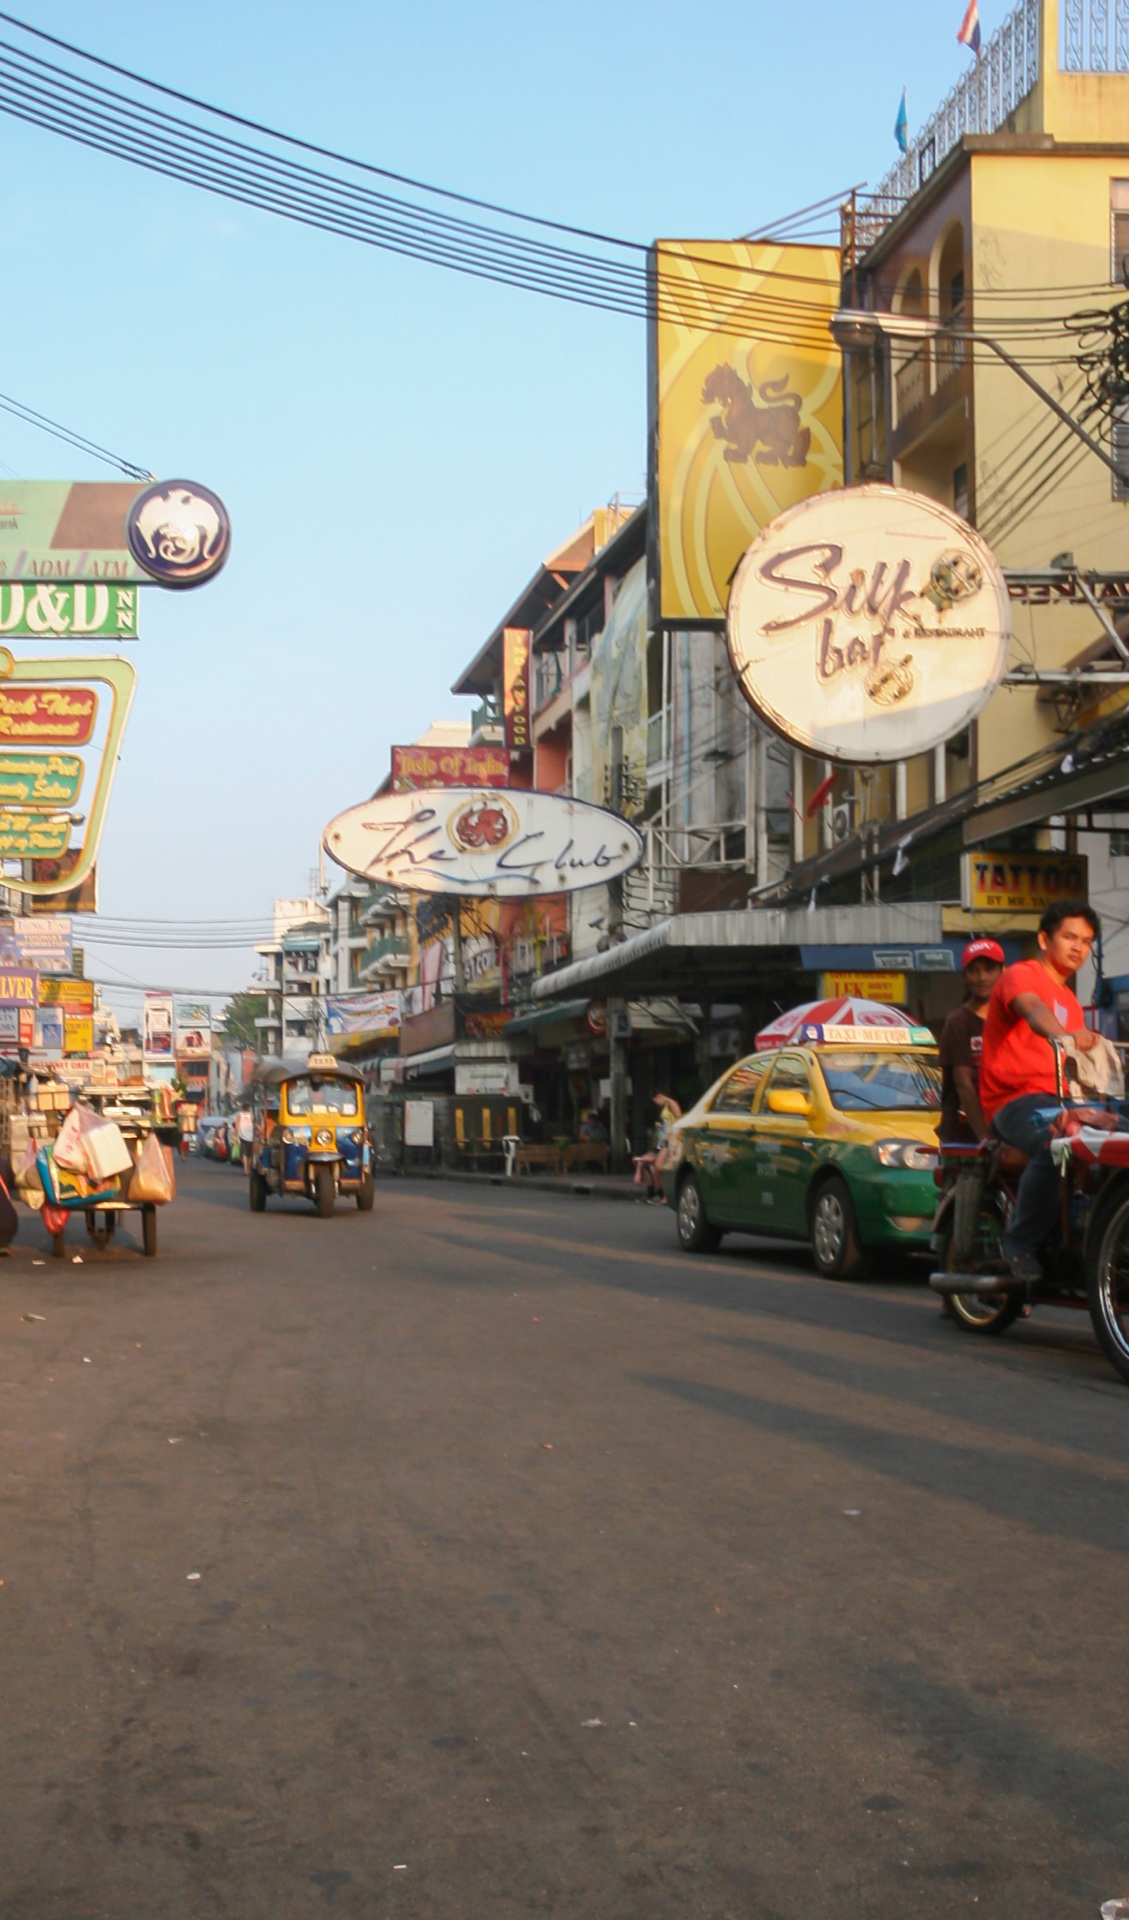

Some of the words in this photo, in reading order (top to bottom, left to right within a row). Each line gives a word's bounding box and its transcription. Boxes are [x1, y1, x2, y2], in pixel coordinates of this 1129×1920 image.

[28, 559, 70, 577] ADM
[89, 560, 128, 577] ATM
[759, 543, 922, 634] Silk
[818, 617, 895, 679] bar
[915, 627, 986, 639] RESTAURANT
[513, 703, 527, 746] FOOD
[361, 808, 457, 873] The
[496, 831, 622, 869] Club
[975, 863, 1081, 893] TATTOO
[987, 895, 1002, 906] BY
[1008, 896, 1025, 906] MR
